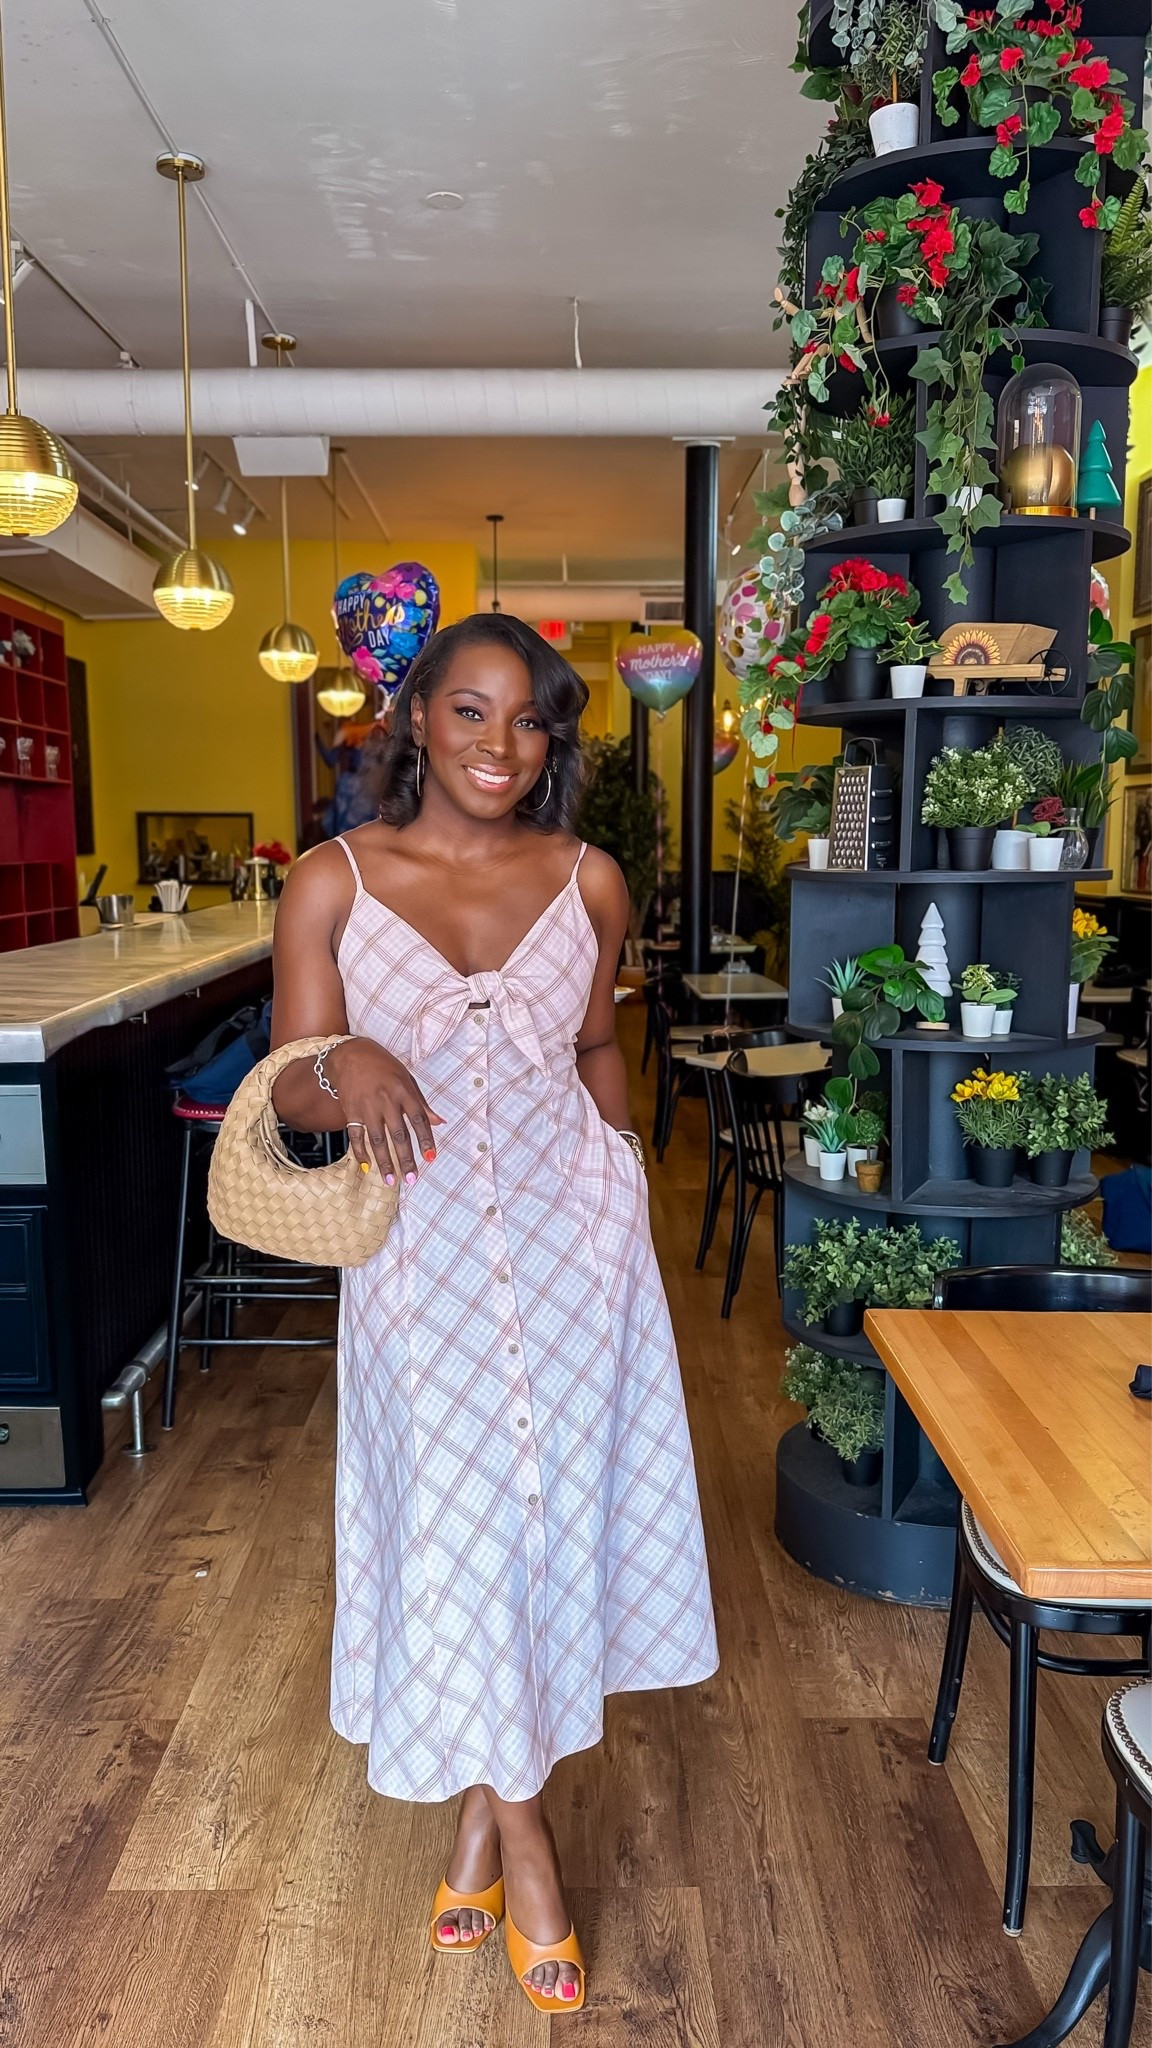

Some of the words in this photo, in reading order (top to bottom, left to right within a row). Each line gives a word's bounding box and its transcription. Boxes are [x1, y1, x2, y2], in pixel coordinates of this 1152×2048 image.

[337, 594, 366, 615] HAPPY
[368, 630, 390, 648] DAY
[638, 642, 676, 655] HAPPY
[646, 669, 672, 680] DAY!
